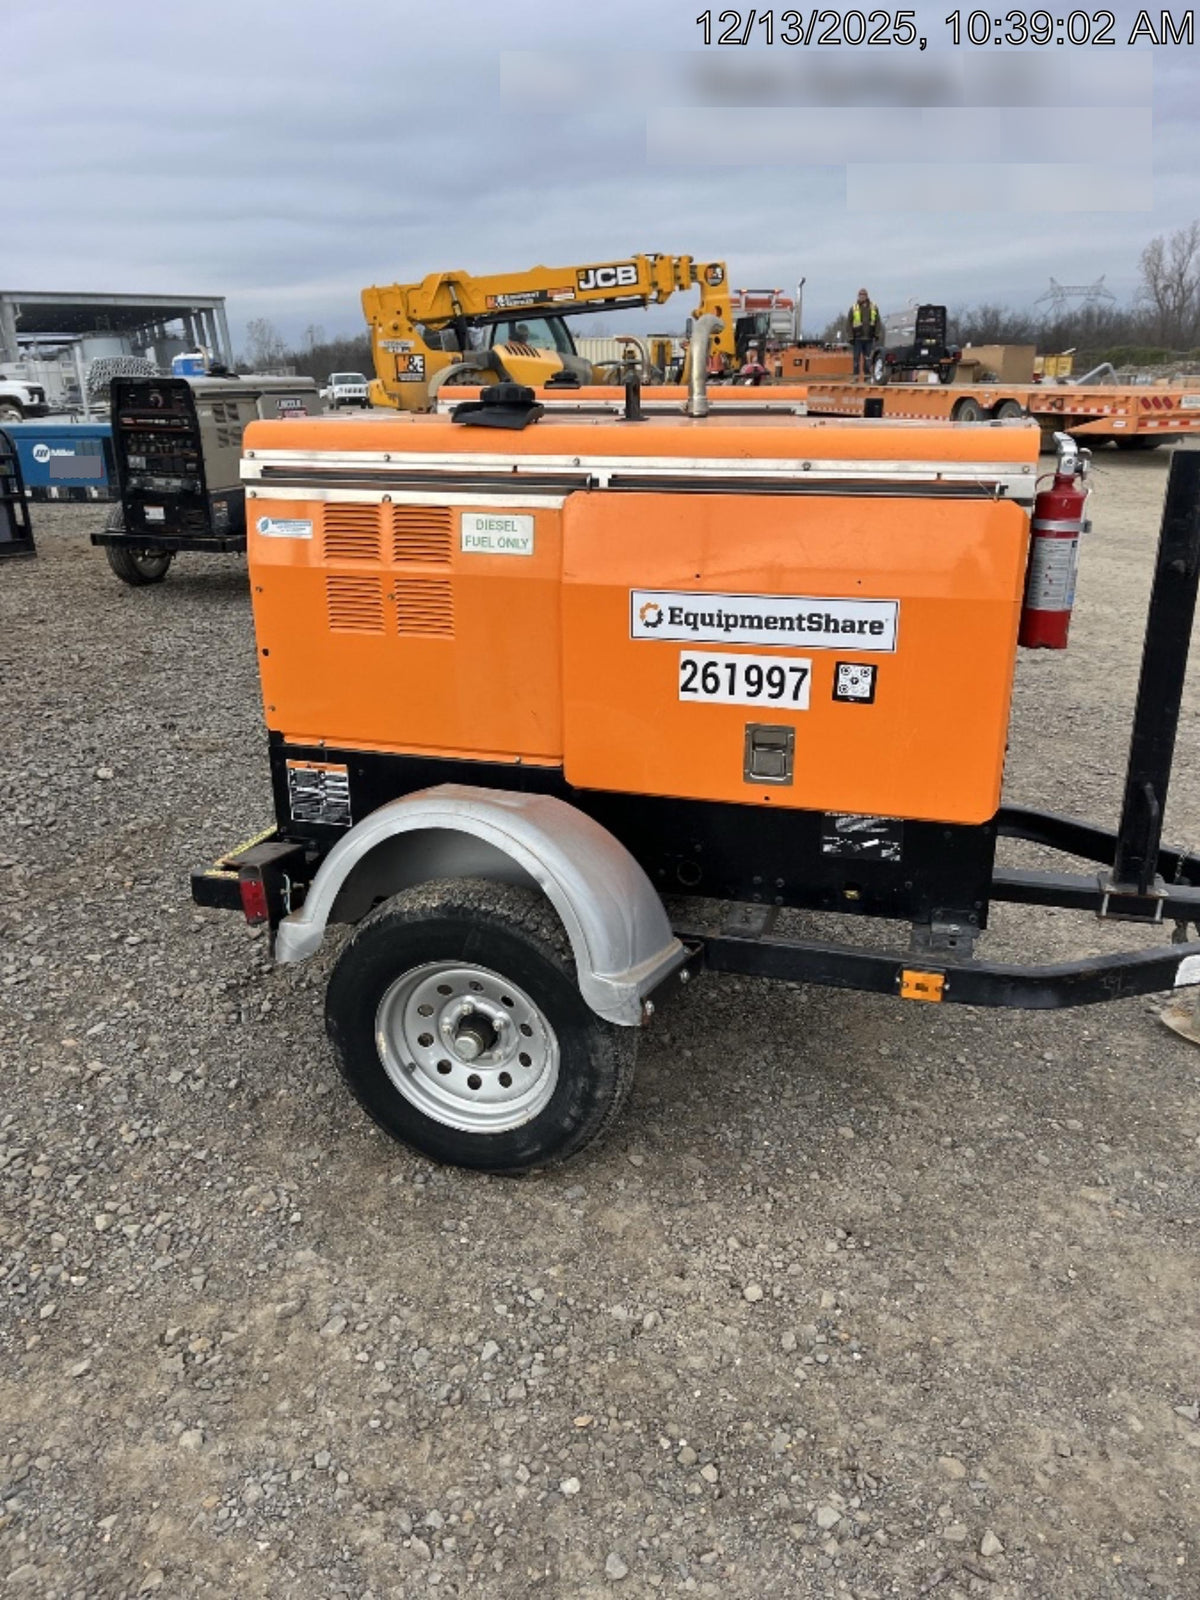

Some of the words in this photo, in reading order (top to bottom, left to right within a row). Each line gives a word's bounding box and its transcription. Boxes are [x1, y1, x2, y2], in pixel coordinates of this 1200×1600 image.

[579, 265, 638, 289] JCB
[396, 354, 424, 372] H&E
[475, 518, 518, 533] DIESEL
[465, 535, 495, 549] FUEL
[498, 536, 529, 549] ONLY
[668, 605, 885, 636] EquipmentShare
[680, 659, 809, 701] 261997
